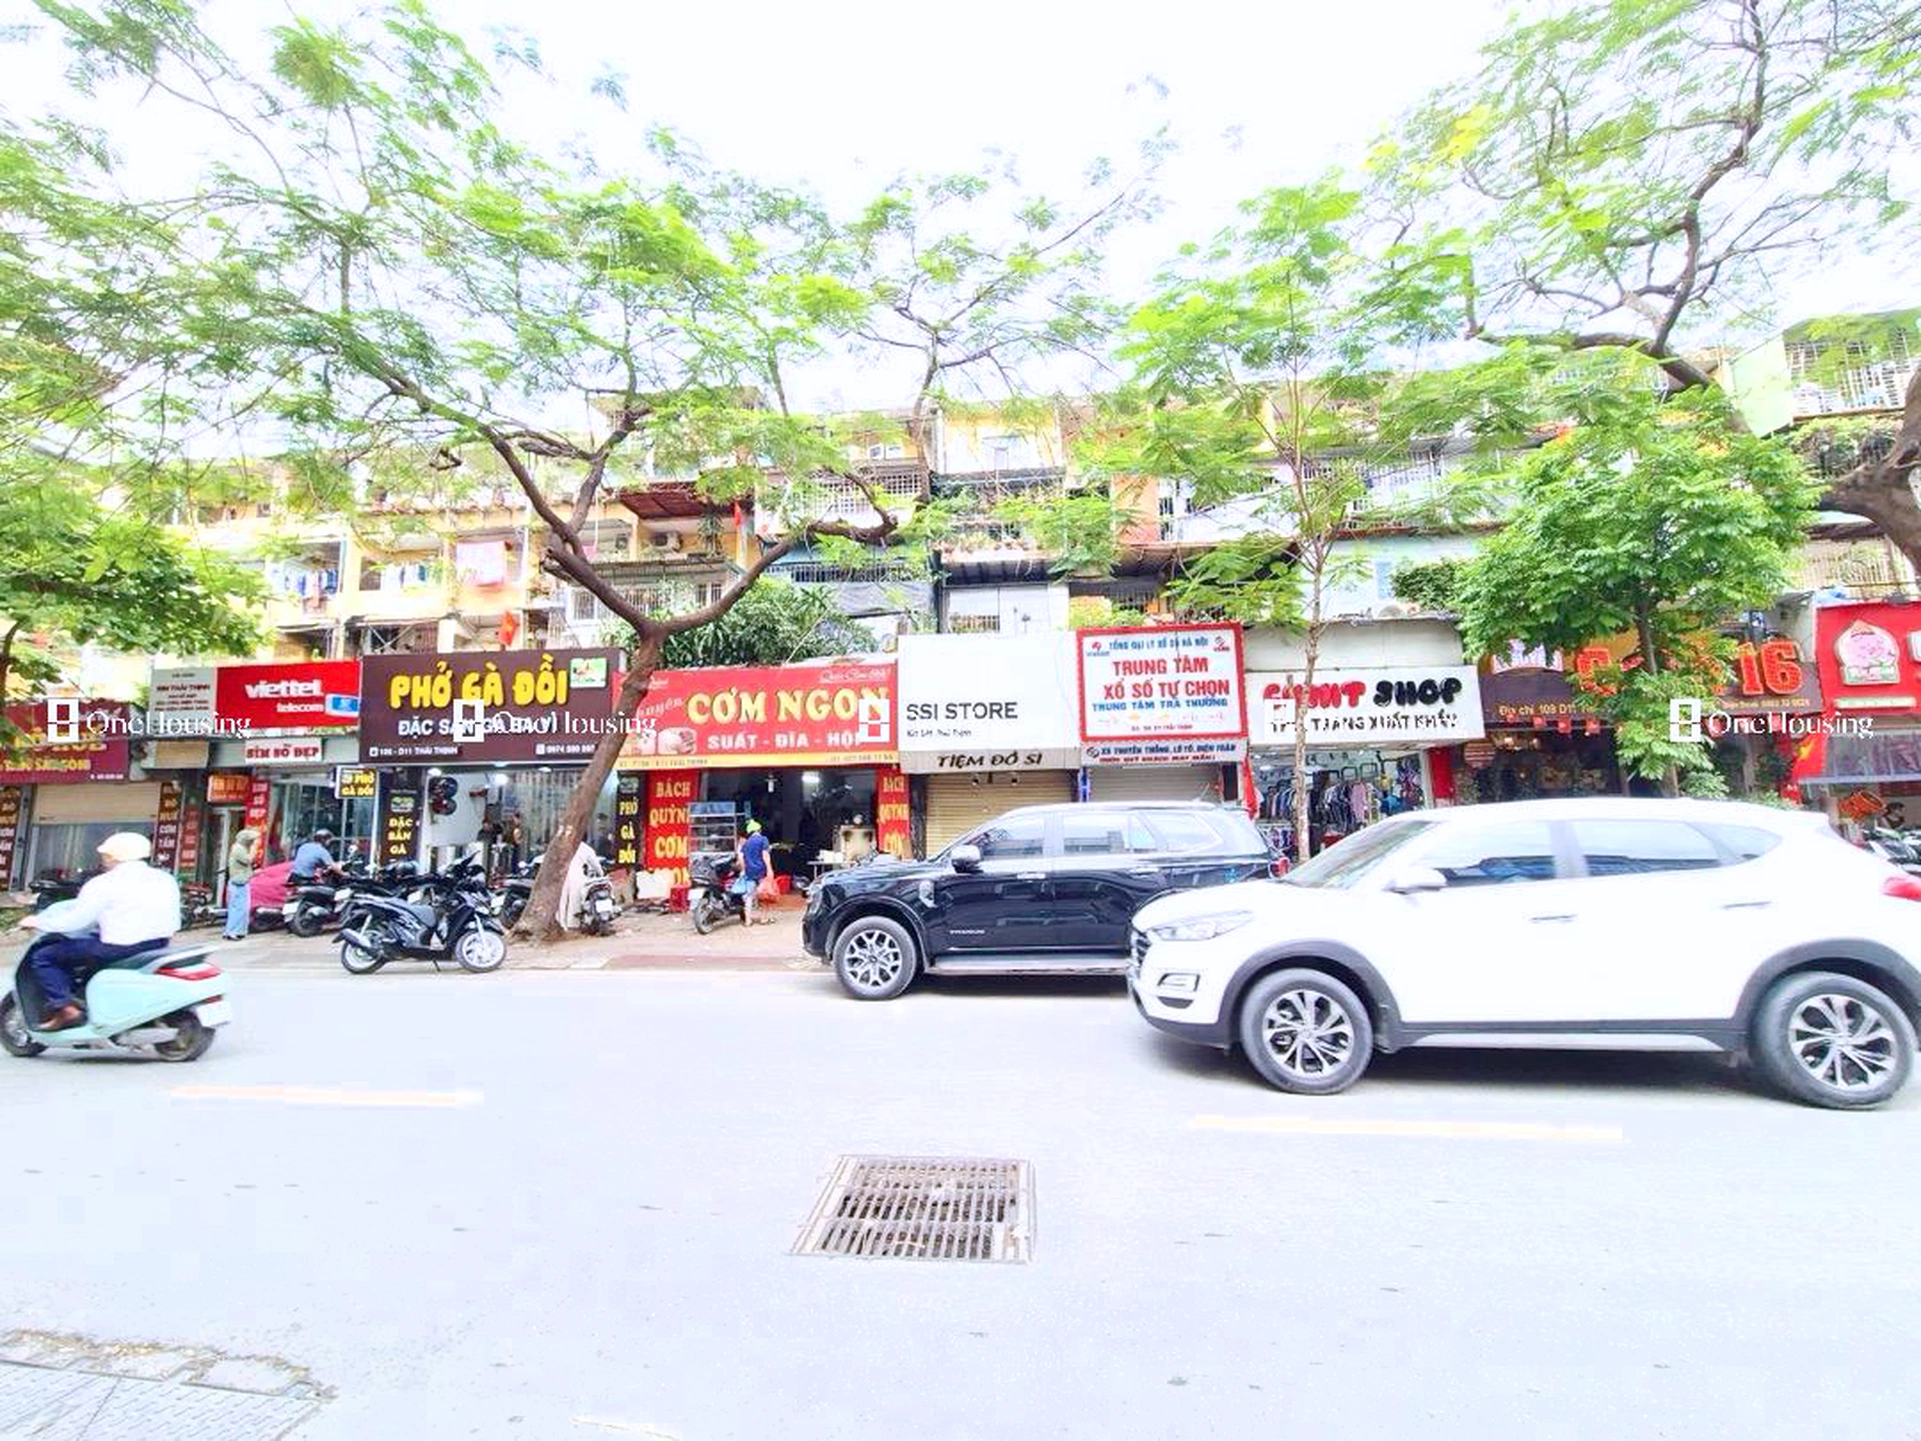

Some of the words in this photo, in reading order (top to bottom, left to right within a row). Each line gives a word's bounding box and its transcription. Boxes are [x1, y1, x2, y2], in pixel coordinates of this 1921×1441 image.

[1113, 658, 1168, 676] TRUNG
[1173, 655, 1209, 673] TÂM
[1738, 641, 1803, 696] 16
[390, 660, 453, 709] PHỞ
[461, 662, 504, 707] GÀ
[512, 653, 568, 706] ĐỒI
[1103, 678, 1125, 700] XỔ
[1132, 677, 1154, 699] SỐ
[1158, 681, 1180, 701] TỰ
[1185, 680, 1230, 699] CHỌN
[1373, 677, 1463, 707] SHOP
[277, 702, 325, 713] telecom
[687, 685, 768, 724] CƠM
[907, 703, 938, 720] SSI
[945, 701, 1018, 720] STORE
[1092, 702, 1127, 713] TRUNG
[1132, 701, 1155, 711] TÂM
[398, 716, 432, 740] ĐẶC
[937, 754, 985, 769] TIỆM
[1022, 753, 1043, 766] SI
[655, 778, 691, 798] BÁCH
[388, 815, 414, 831] ĐẶC
[649, 803, 690, 827] QUỲN
[389, 843, 407, 855] GÀ
[654, 833, 689, 859] CƠM
